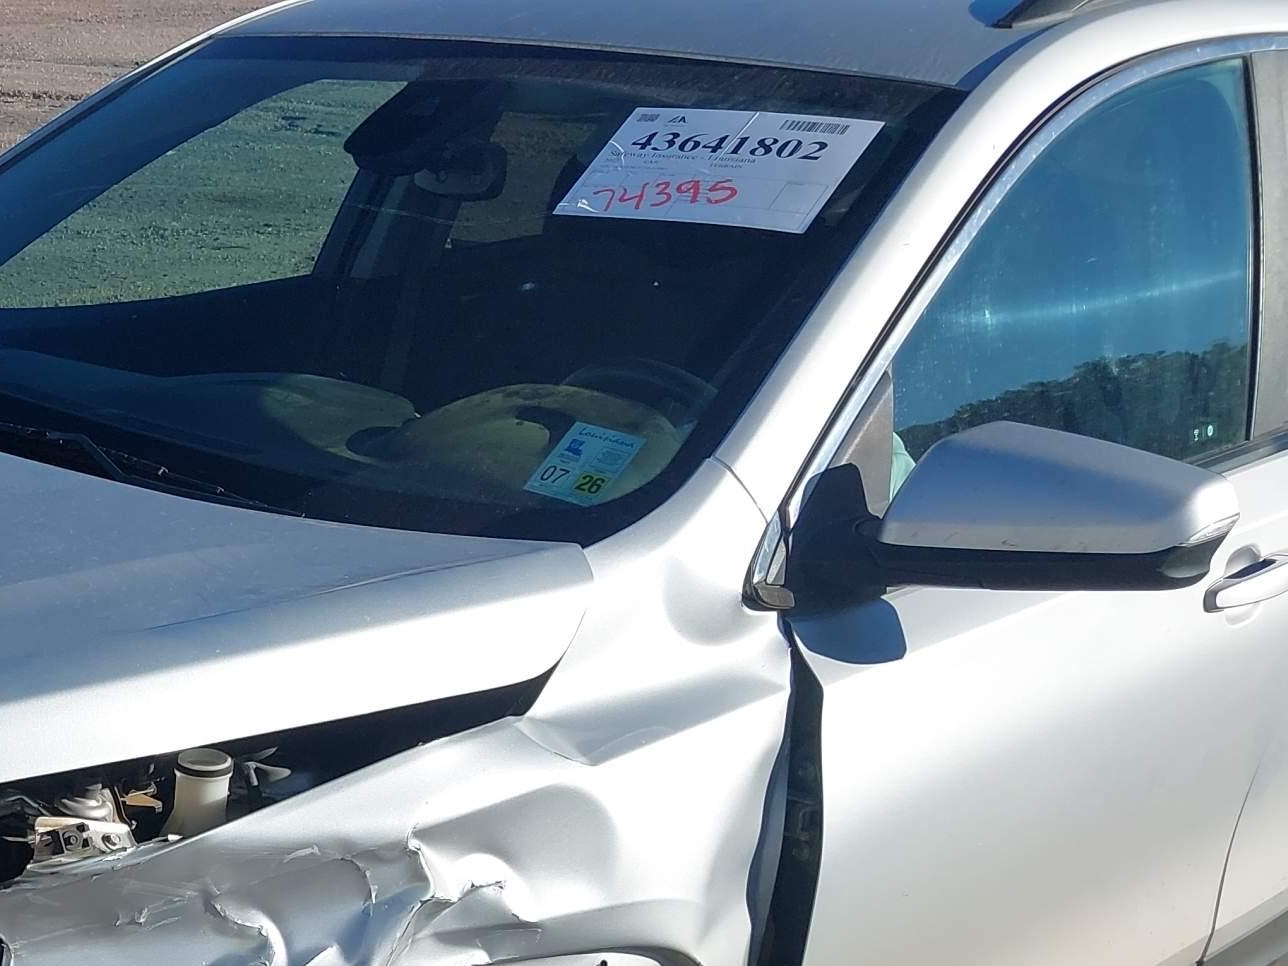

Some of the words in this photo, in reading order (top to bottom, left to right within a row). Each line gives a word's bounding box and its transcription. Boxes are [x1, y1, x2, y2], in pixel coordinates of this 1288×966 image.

[631, 131, 828, 161] 43641802
[593, 178, 739, 212] 74395
[540, 465, 571, 484] 07
[574, 475, 606, 494] 26
